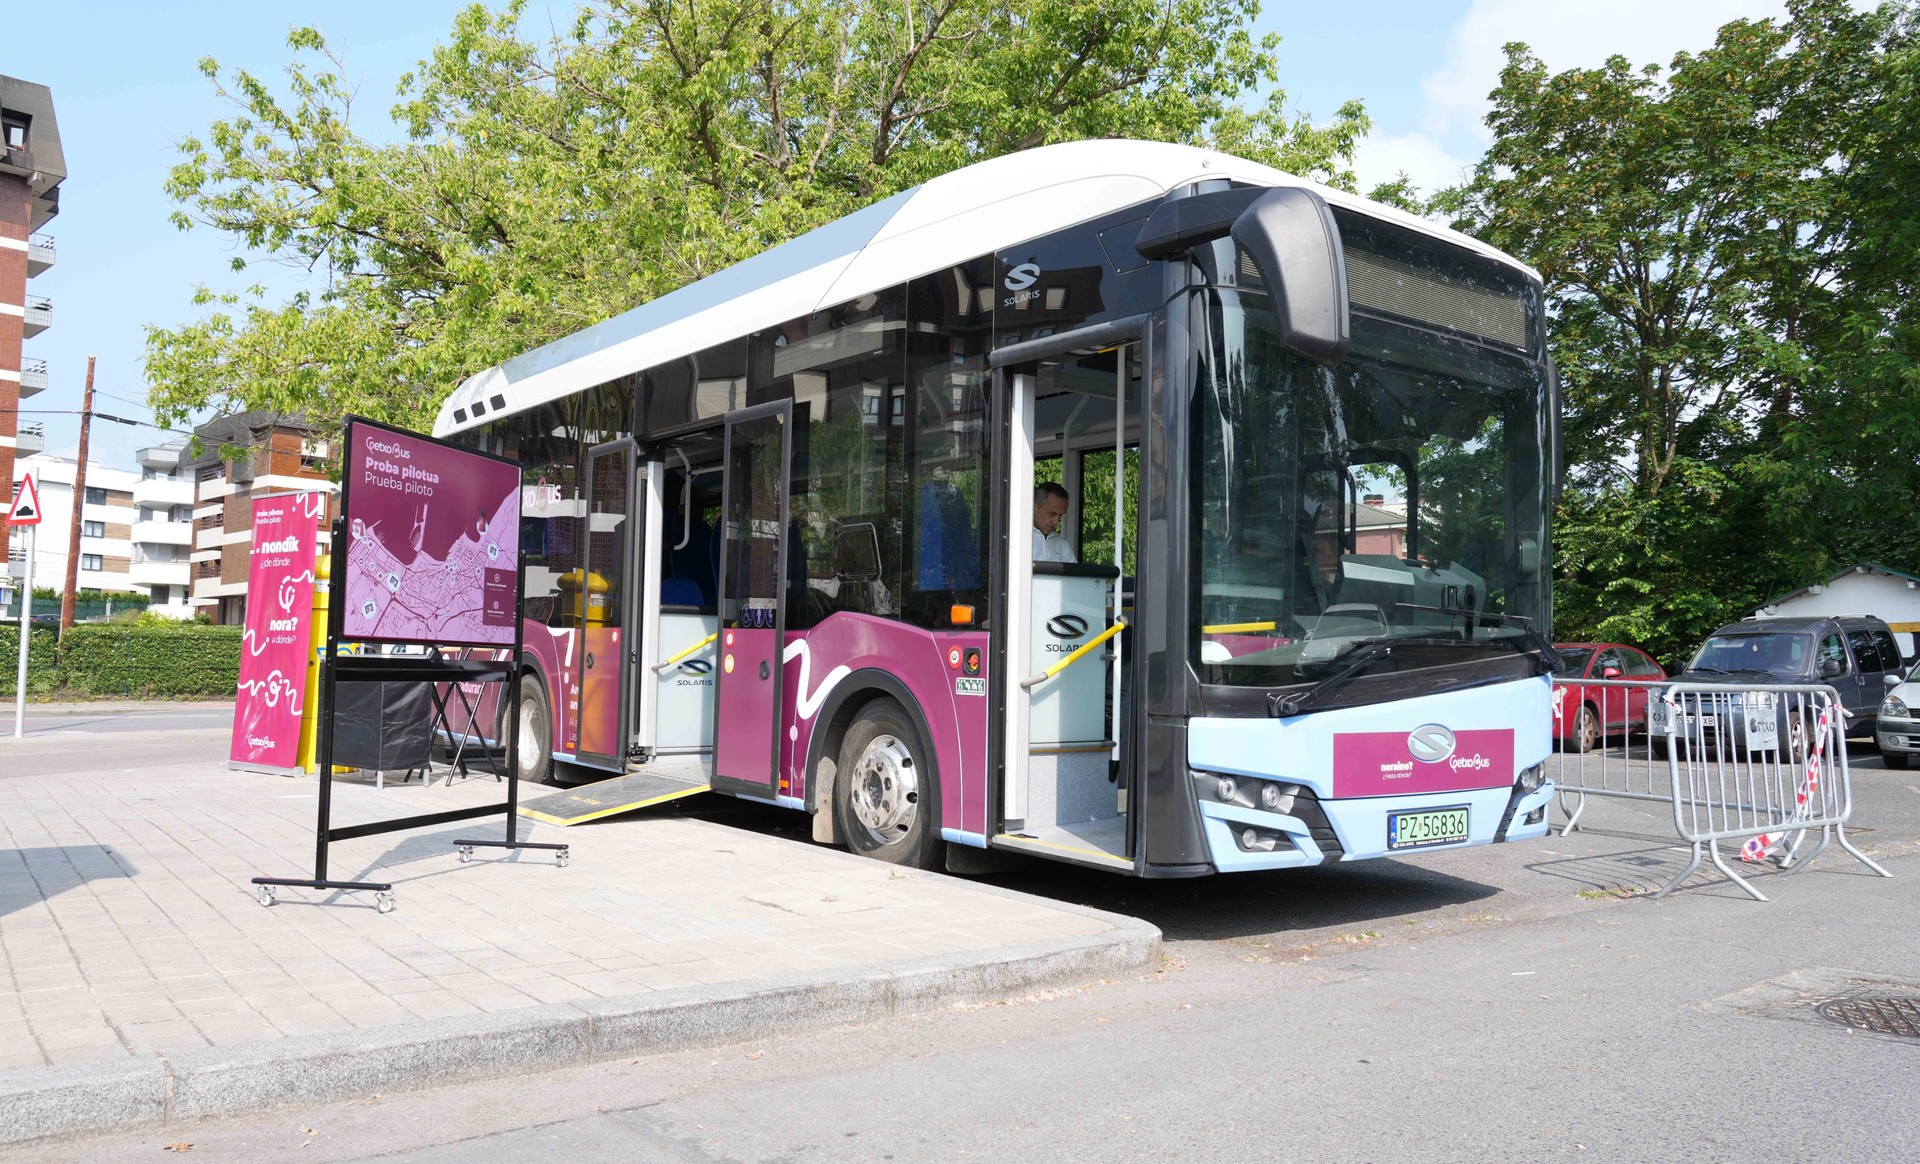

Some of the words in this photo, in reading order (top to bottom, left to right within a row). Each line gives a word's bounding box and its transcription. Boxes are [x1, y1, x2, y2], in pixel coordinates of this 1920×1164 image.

[1003, 290, 1040, 307] SOLARIS
[366, 456, 399, 475] Proba
[402, 464, 439, 484] pilotua
[365, 471, 402, 490] Prueba
[405, 481, 433, 496] piloto
[261, 535, 299, 554] nondik
[269, 616, 298, 631] nora?
[1380, 761, 1414, 772] noraino?
[1400, 816, 1418, 839] PZ
[1423, 813, 1464, 837] 5G836
